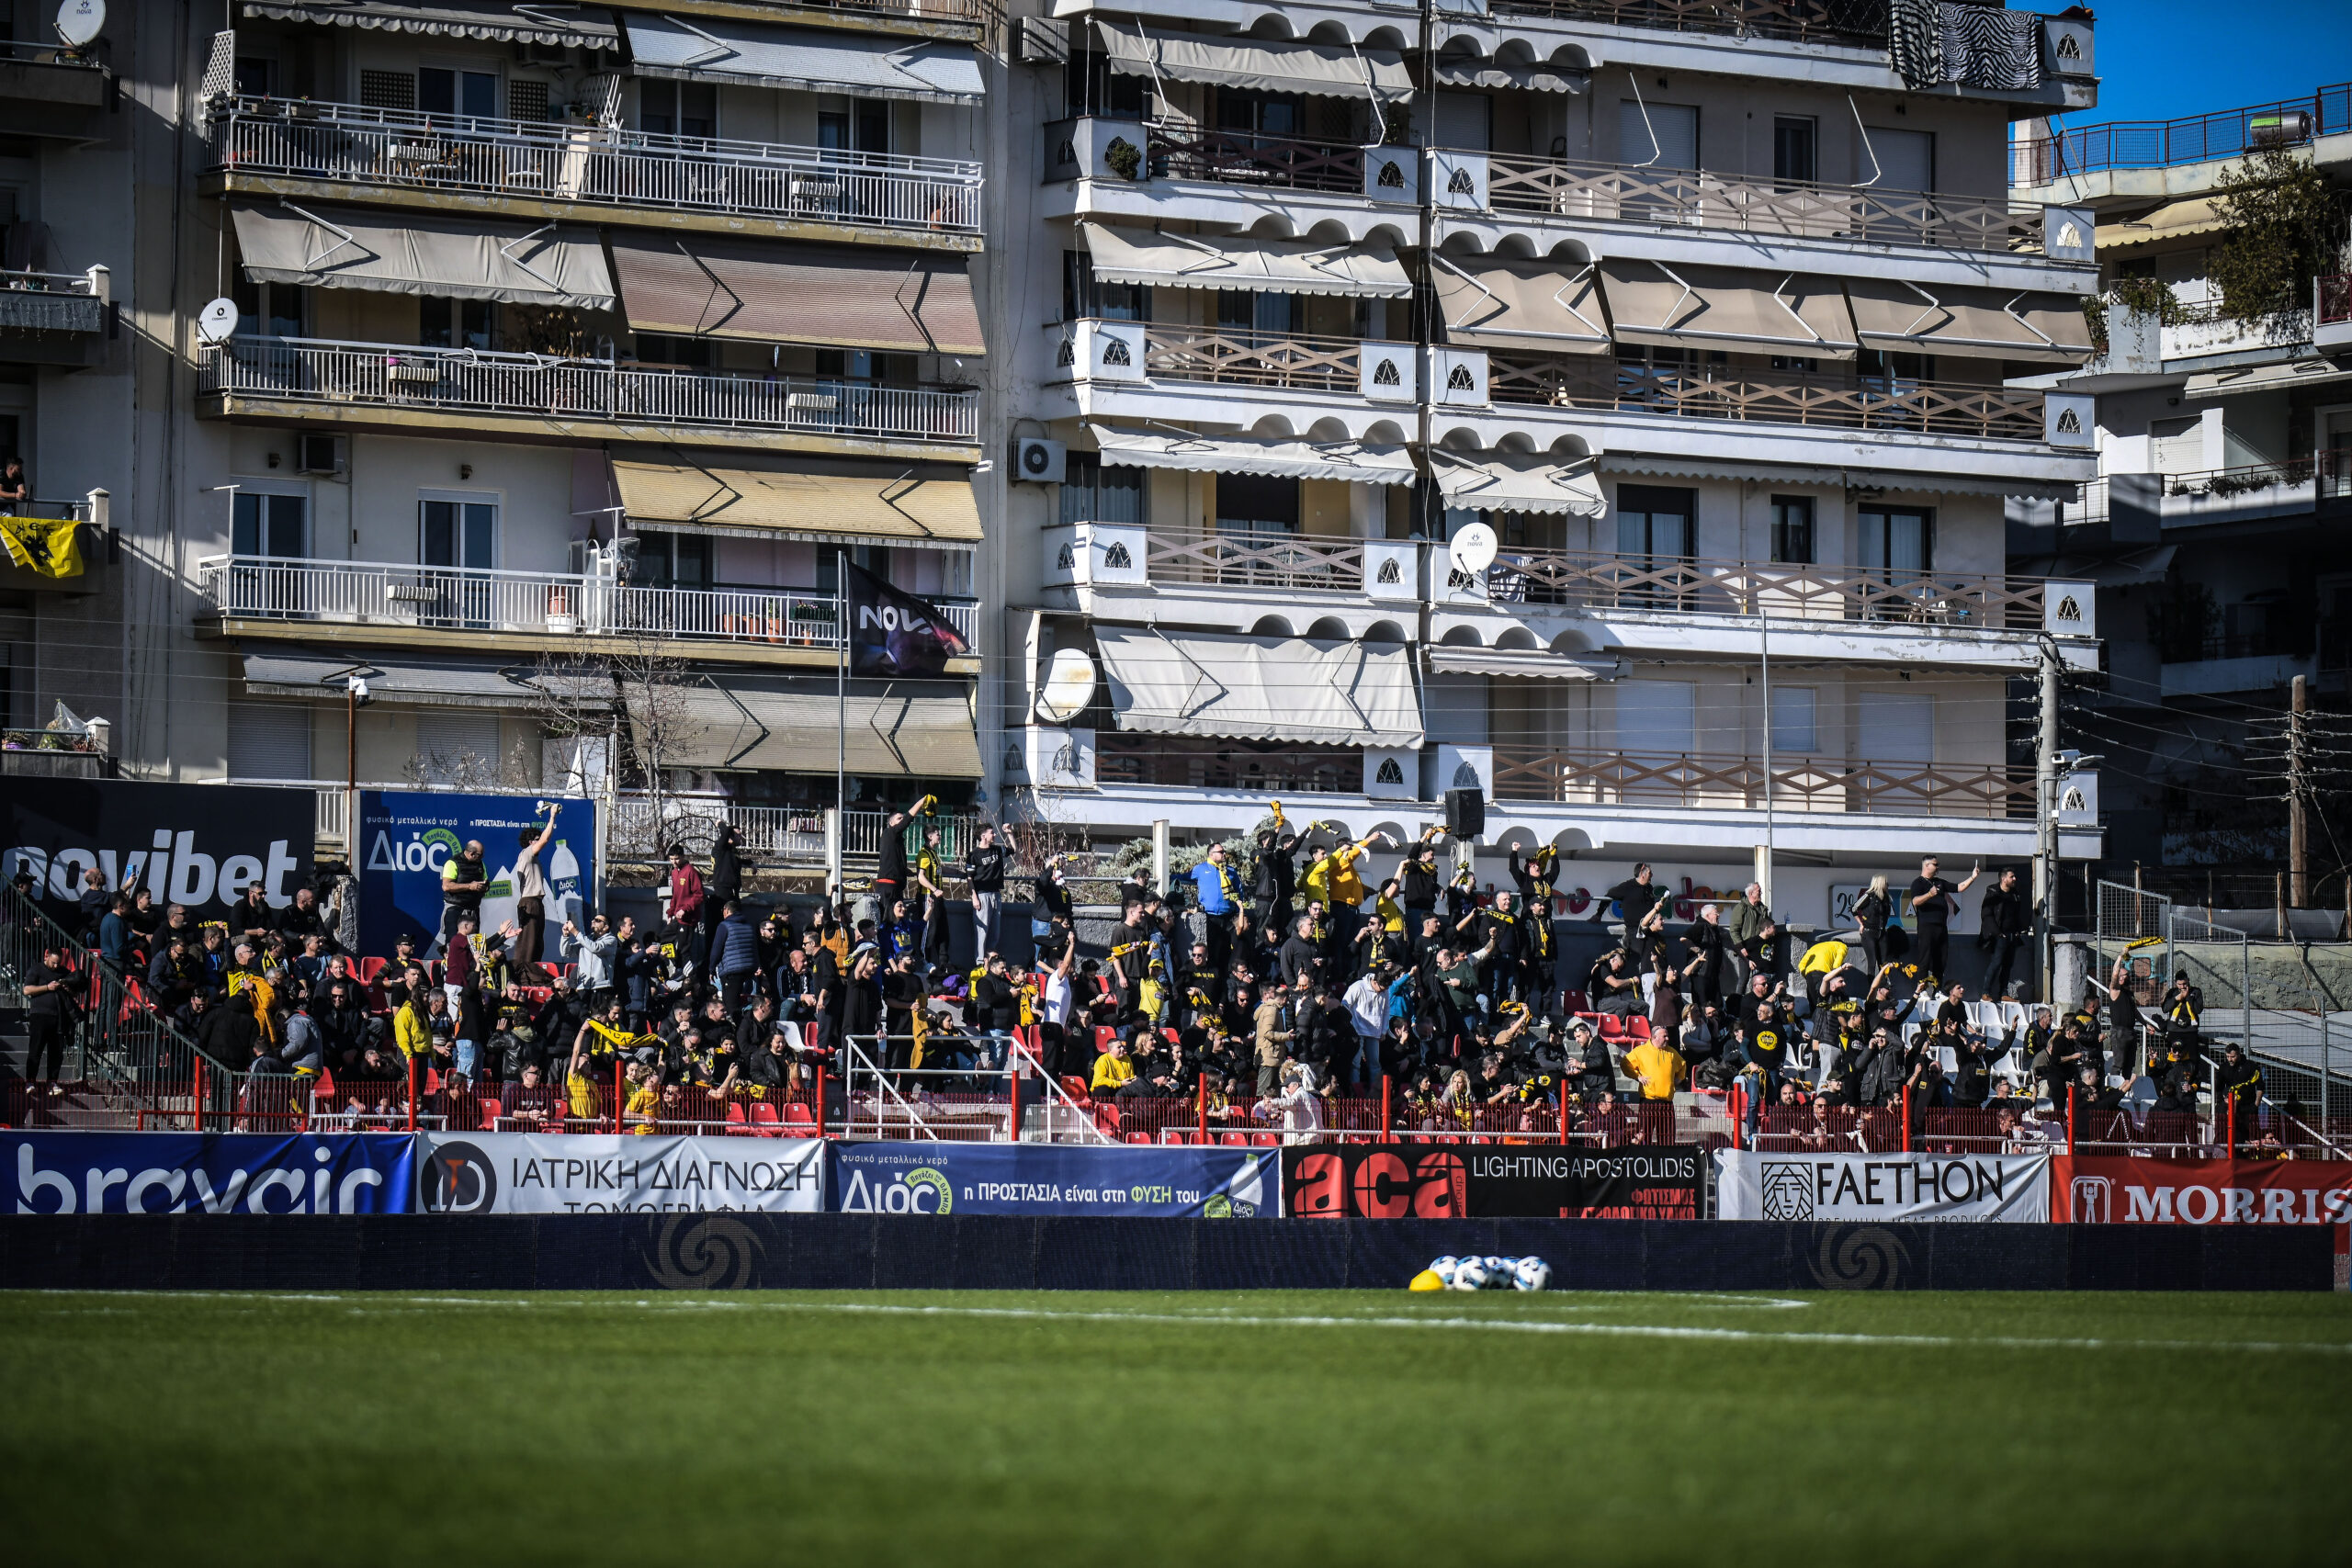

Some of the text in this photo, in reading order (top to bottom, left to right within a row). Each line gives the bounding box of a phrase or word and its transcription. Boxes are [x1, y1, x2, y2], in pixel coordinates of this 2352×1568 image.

[366, 816, 458, 827] φυσικό μεταλλικό νερό
[513, 1158, 820, 1191] ΙΑΤΡΙΚΗ ΔΙΑΓΝΩΣΗ
[841, 1154, 948, 1167] φυσικό μεταλλικό νερό
[1473, 1156, 1695, 1179] LIGHTING APOSTOLIDIS
[17, 1143, 383, 1213] bravair
[1294, 1152, 1467, 1218] aca
[1816, 1160, 2004, 1205] FAETHON
[978, 1182, 1061, 1201] ΠΡΟΣΤΑΣΙΑ
[1065, 1183, 1098, 1202] είναι
[1102, 1189, 1125, 1203] στη
[1131, 1185, 1171, 1203] ΦΥΣΗ
[1176, 1189, 1199, 1203] του
[1631, 1188, 1695, 1205] ΦΩΤΙΣΜΟΣ
[2124, 1185, 2352, 1224] MORRIS
